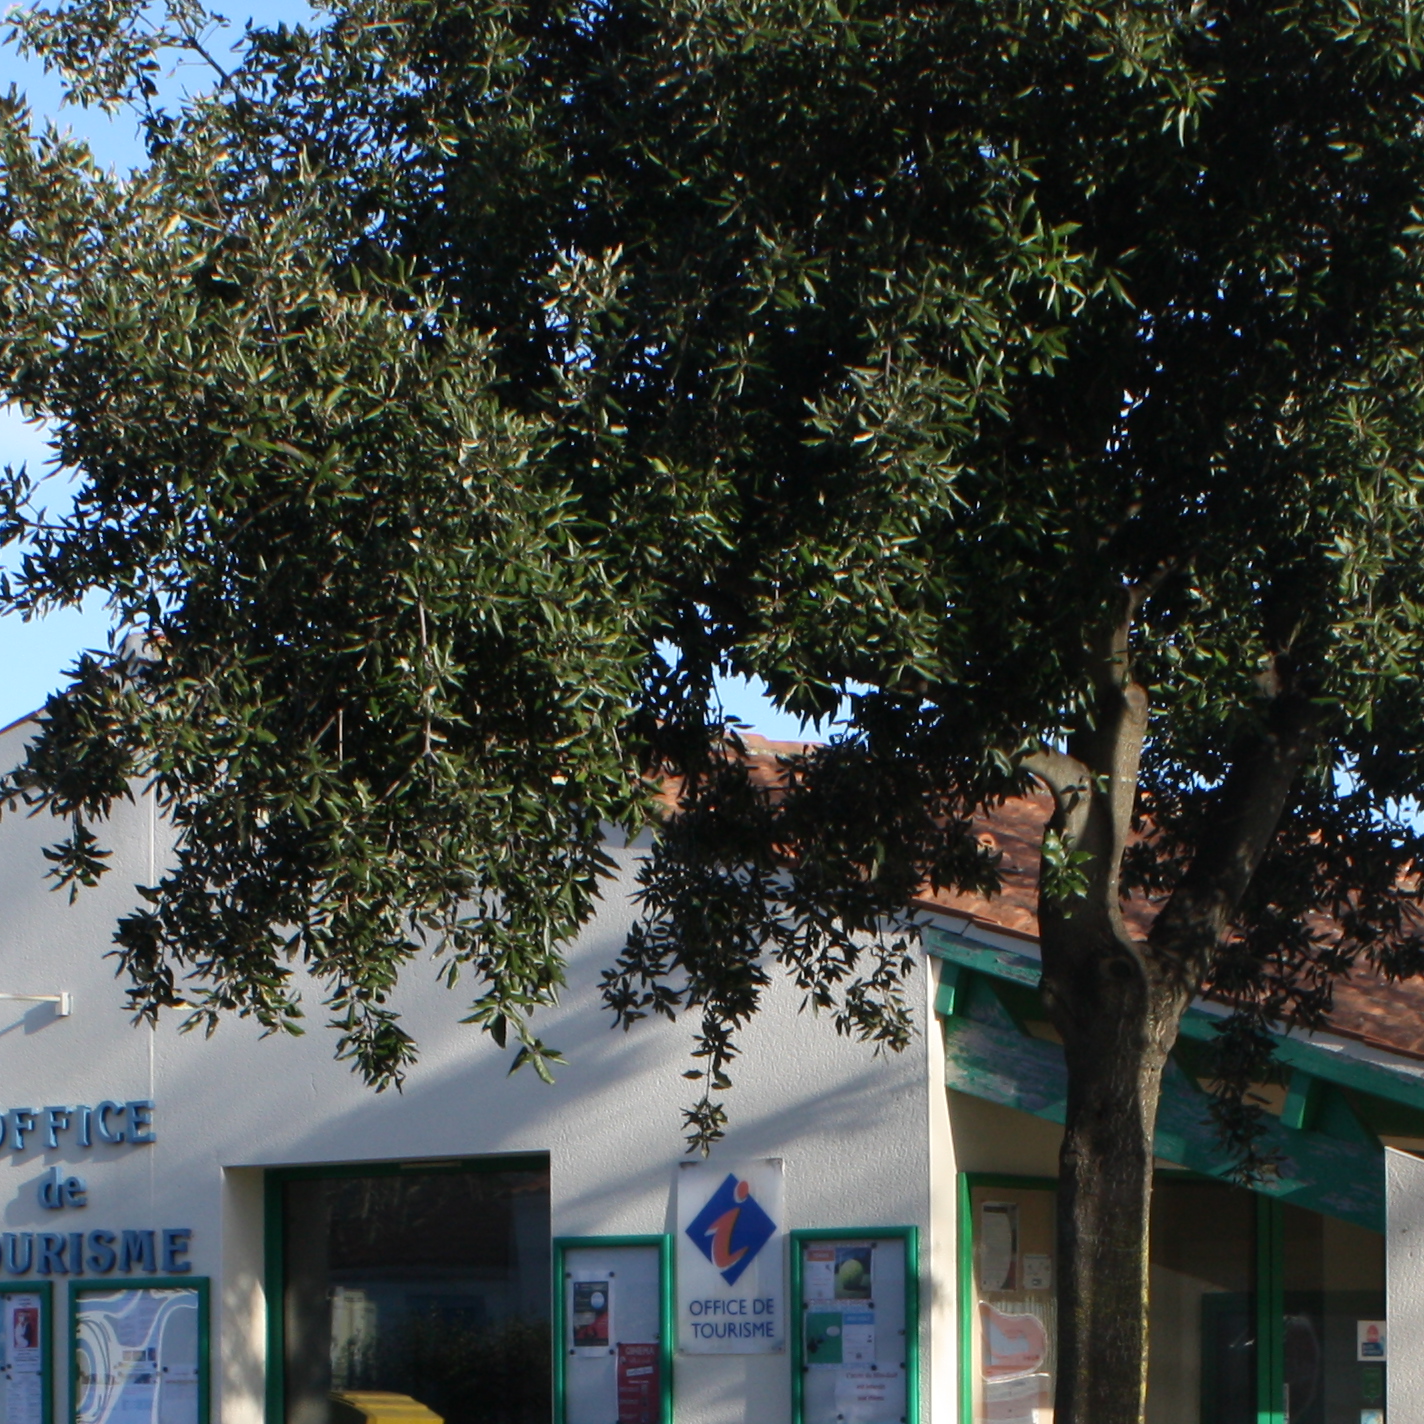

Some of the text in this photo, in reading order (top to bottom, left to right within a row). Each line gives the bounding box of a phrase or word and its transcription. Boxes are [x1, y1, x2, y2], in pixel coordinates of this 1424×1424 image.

[37, 1166, 88, 1209] de
[689, 1299, 774, 1316] OFFICE DE
[691, 1321, 774, 1339] TOURISME
